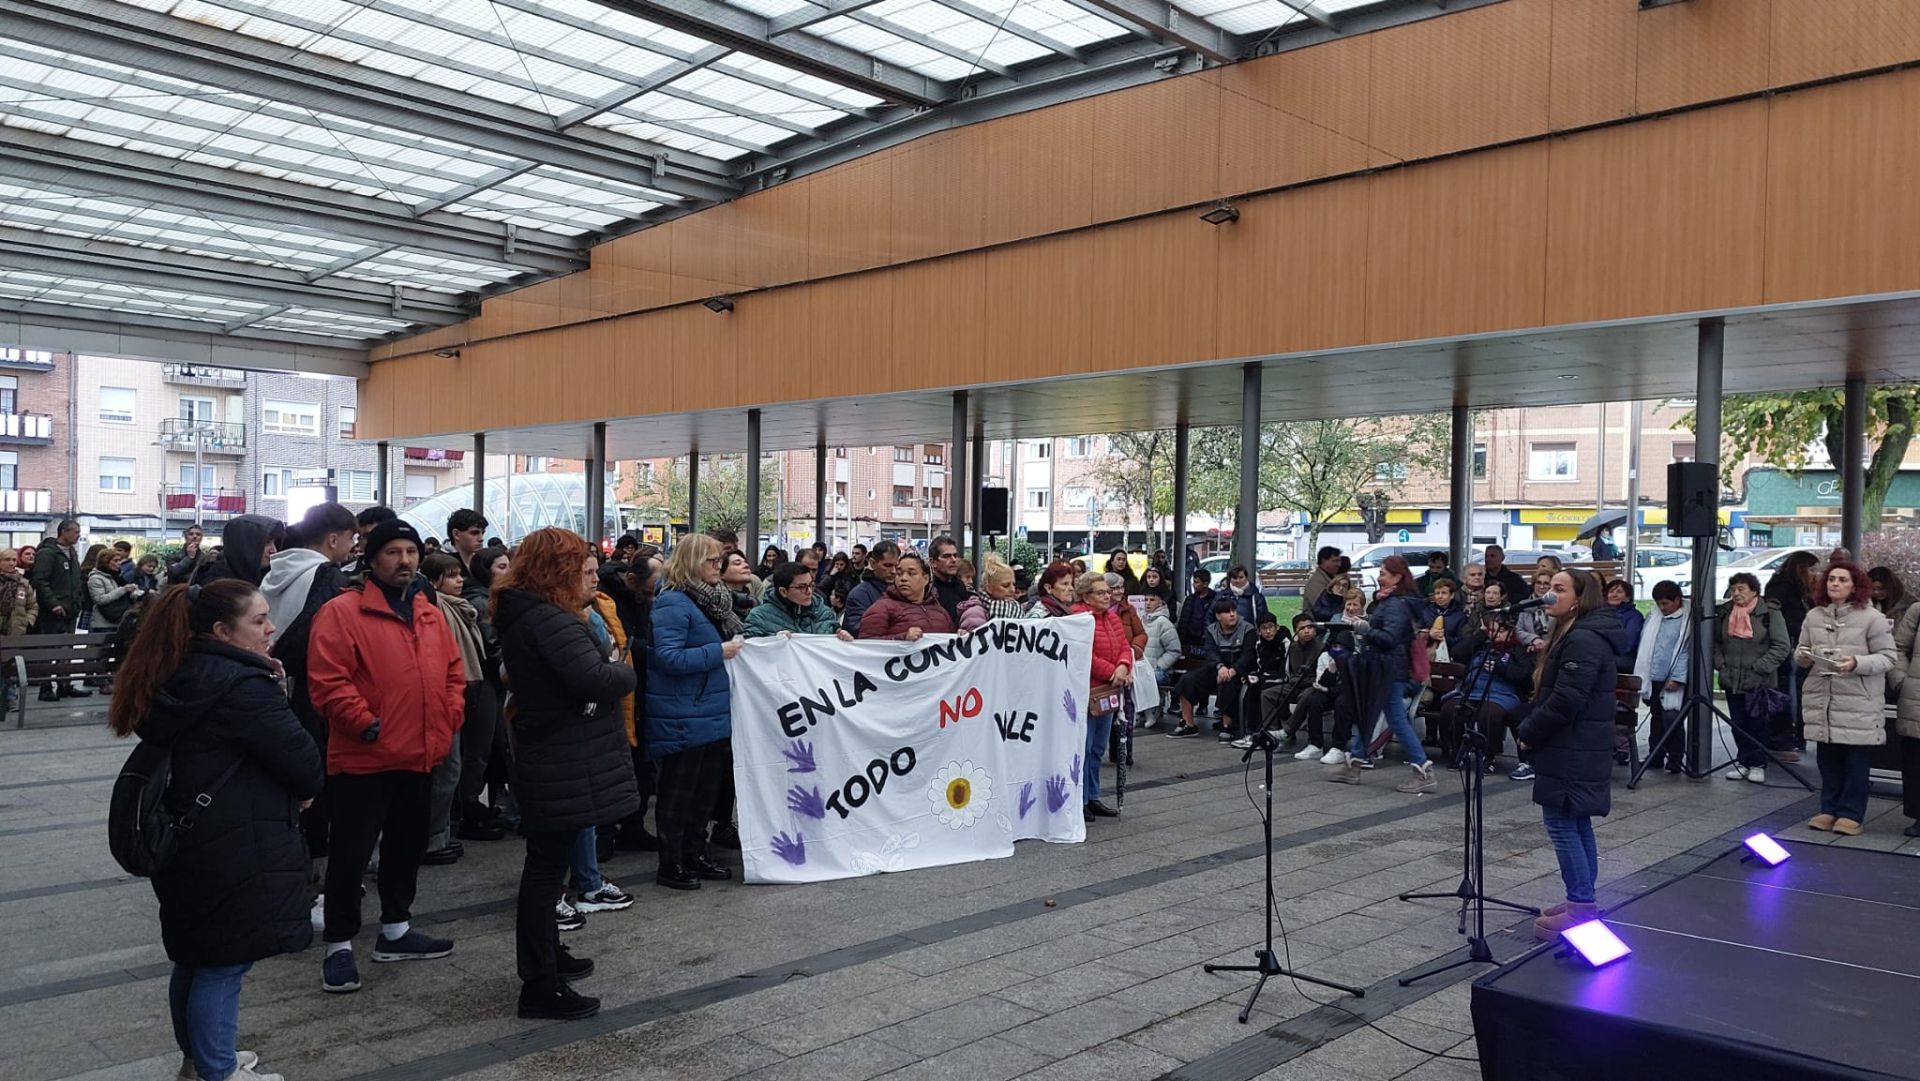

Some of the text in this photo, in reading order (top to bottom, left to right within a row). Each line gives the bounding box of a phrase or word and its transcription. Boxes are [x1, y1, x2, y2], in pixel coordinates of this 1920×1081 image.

[777, 621, 1069, 738] EN LA CONVIVENCIA
[939, 687, 983, 729] NO
[825, 746, 917, 819] TODO
